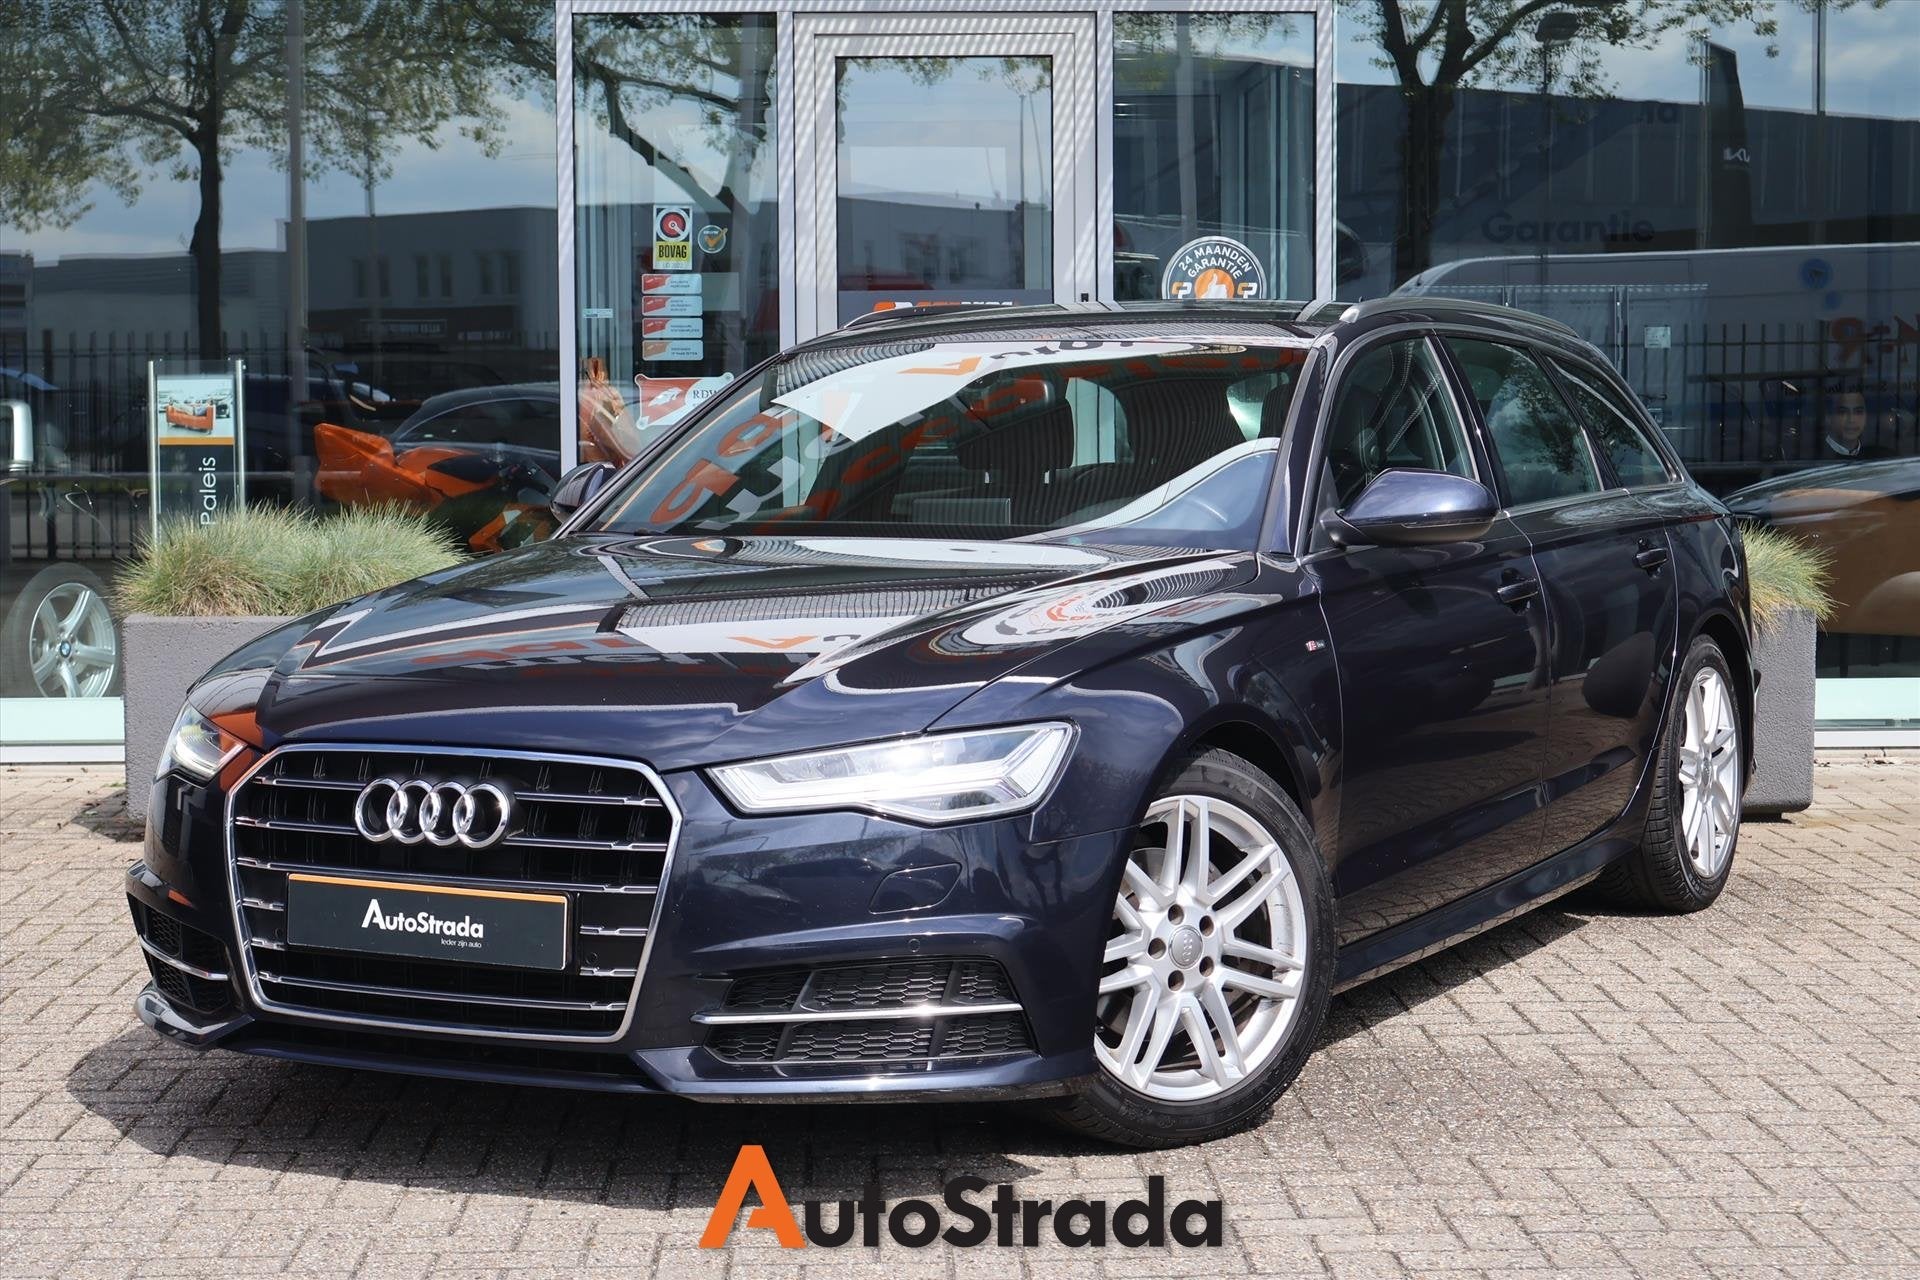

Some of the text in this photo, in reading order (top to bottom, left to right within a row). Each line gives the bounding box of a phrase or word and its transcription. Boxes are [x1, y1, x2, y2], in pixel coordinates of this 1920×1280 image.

[1481, 210, 1655, 243] Garantie
[658, 245, 688, 258] BOVAG
[1178, 245, 1252, 272] 24 MAANDEN
[1187, 257, 1243, 279] GARANTIE
[198, 457, 217, 525] Paleis
[361, 898, 484, 938] AutoStrada
[468, 941, 482, 949] auto
